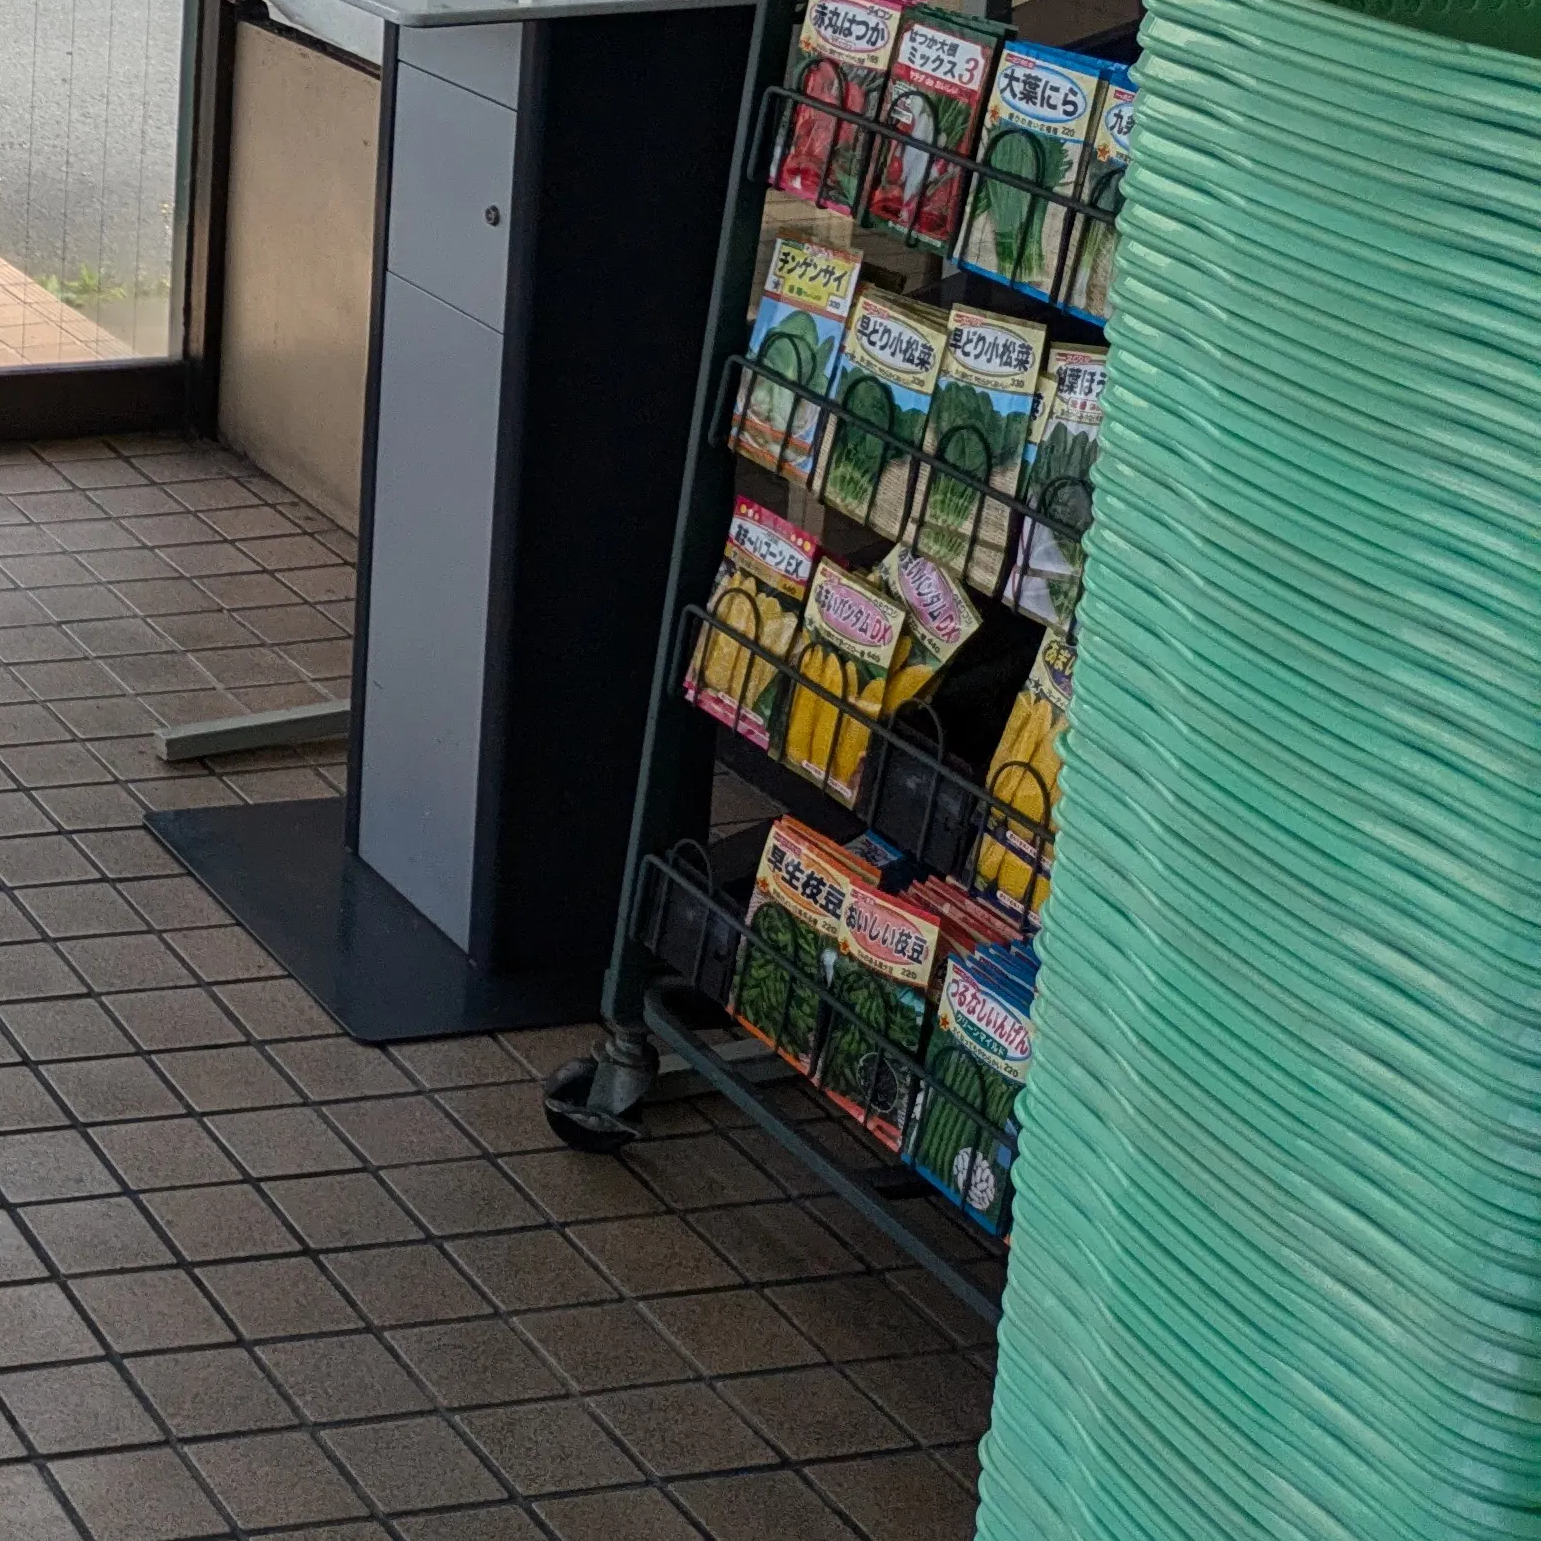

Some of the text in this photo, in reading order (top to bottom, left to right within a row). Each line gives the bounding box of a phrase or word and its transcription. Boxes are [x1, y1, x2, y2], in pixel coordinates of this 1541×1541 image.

[813, 3, 886, 47] 赤丸はつか
[909, 29, 960, 58] はつか大根
[907, 47, 980, 85] ミックス 3
[1000, 69, 1079, 117] 大葉にら
[1061, 126, 1075, 137] 220
[778, 251, 848, 292] チンゲンサイ
[857, 314, 935, 372] 早どり小松菜
[950, 326, 1033, 373] 早どり小松菜
[768, 844, 846, 921] 早生枝豆
[822, 920, 837, 934] 220
[846, 904, 928, 965] おいしい枝豆
[900, 967, 917, 980] 220
[950, 978, 1029, 1056] つるなしいんげん
[956, 1012, 1005, 1056] グリーンマイルド
[1003, 1062, 1019, 1078] 220
